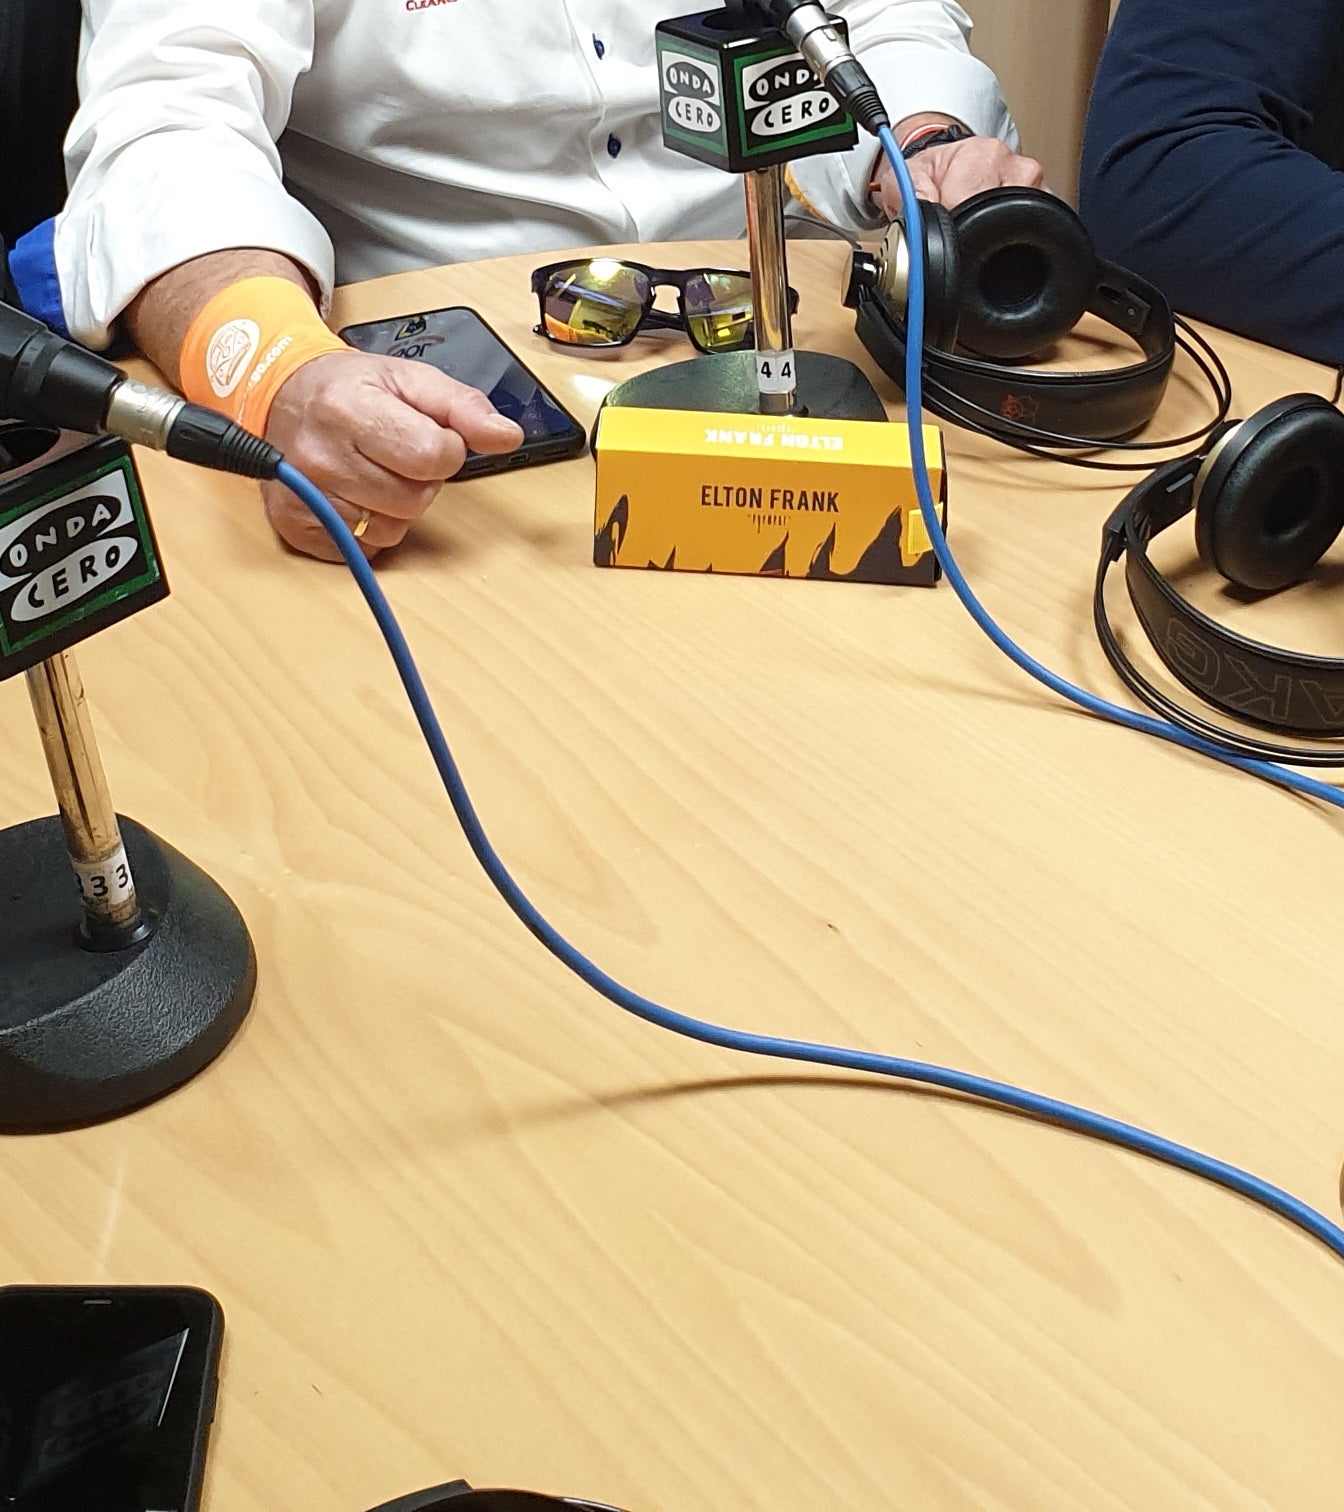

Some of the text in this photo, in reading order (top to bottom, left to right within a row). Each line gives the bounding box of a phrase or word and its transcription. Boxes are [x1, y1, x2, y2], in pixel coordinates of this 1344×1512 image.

[669, 67, 712, 95] ONDA
[756, 68, 818, 97] OND
[675, 100, 714, 128] CERO
[763, 97, 830, 128] CERO
[704, 428, 774, 447] FRANK
[781, 432, 844, 451] ELTON
[701, 484, 840, 513] ELTON FRANK
[9, 503, 112, 568] ONDA
[27, 544, 121, 609] CERO
